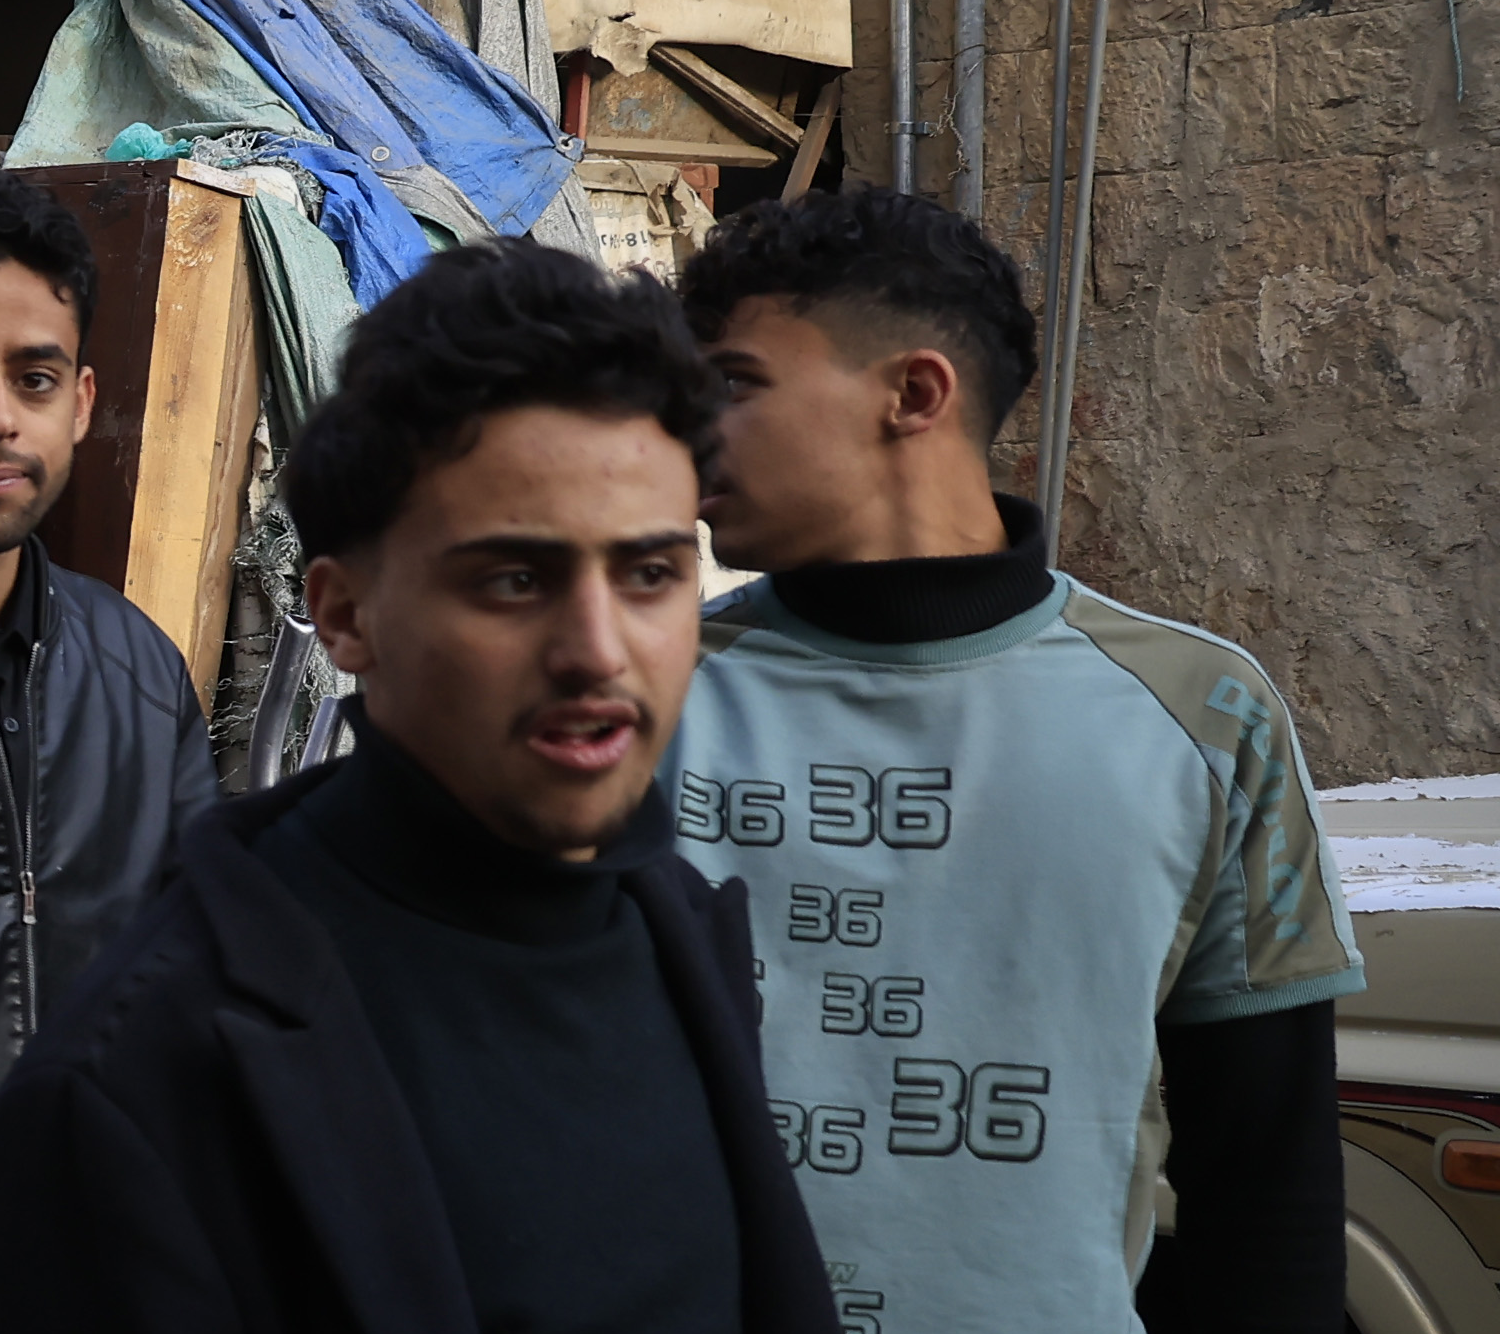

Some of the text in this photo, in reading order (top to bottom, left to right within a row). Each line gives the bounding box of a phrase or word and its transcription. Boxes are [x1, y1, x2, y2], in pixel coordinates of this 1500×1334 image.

[677, 763, 951, 849] 36 36
[789, 883, 884, 947] 36
[821, 971, 925, 1038] 36
[888, 1056, 1050, 1163] 36
